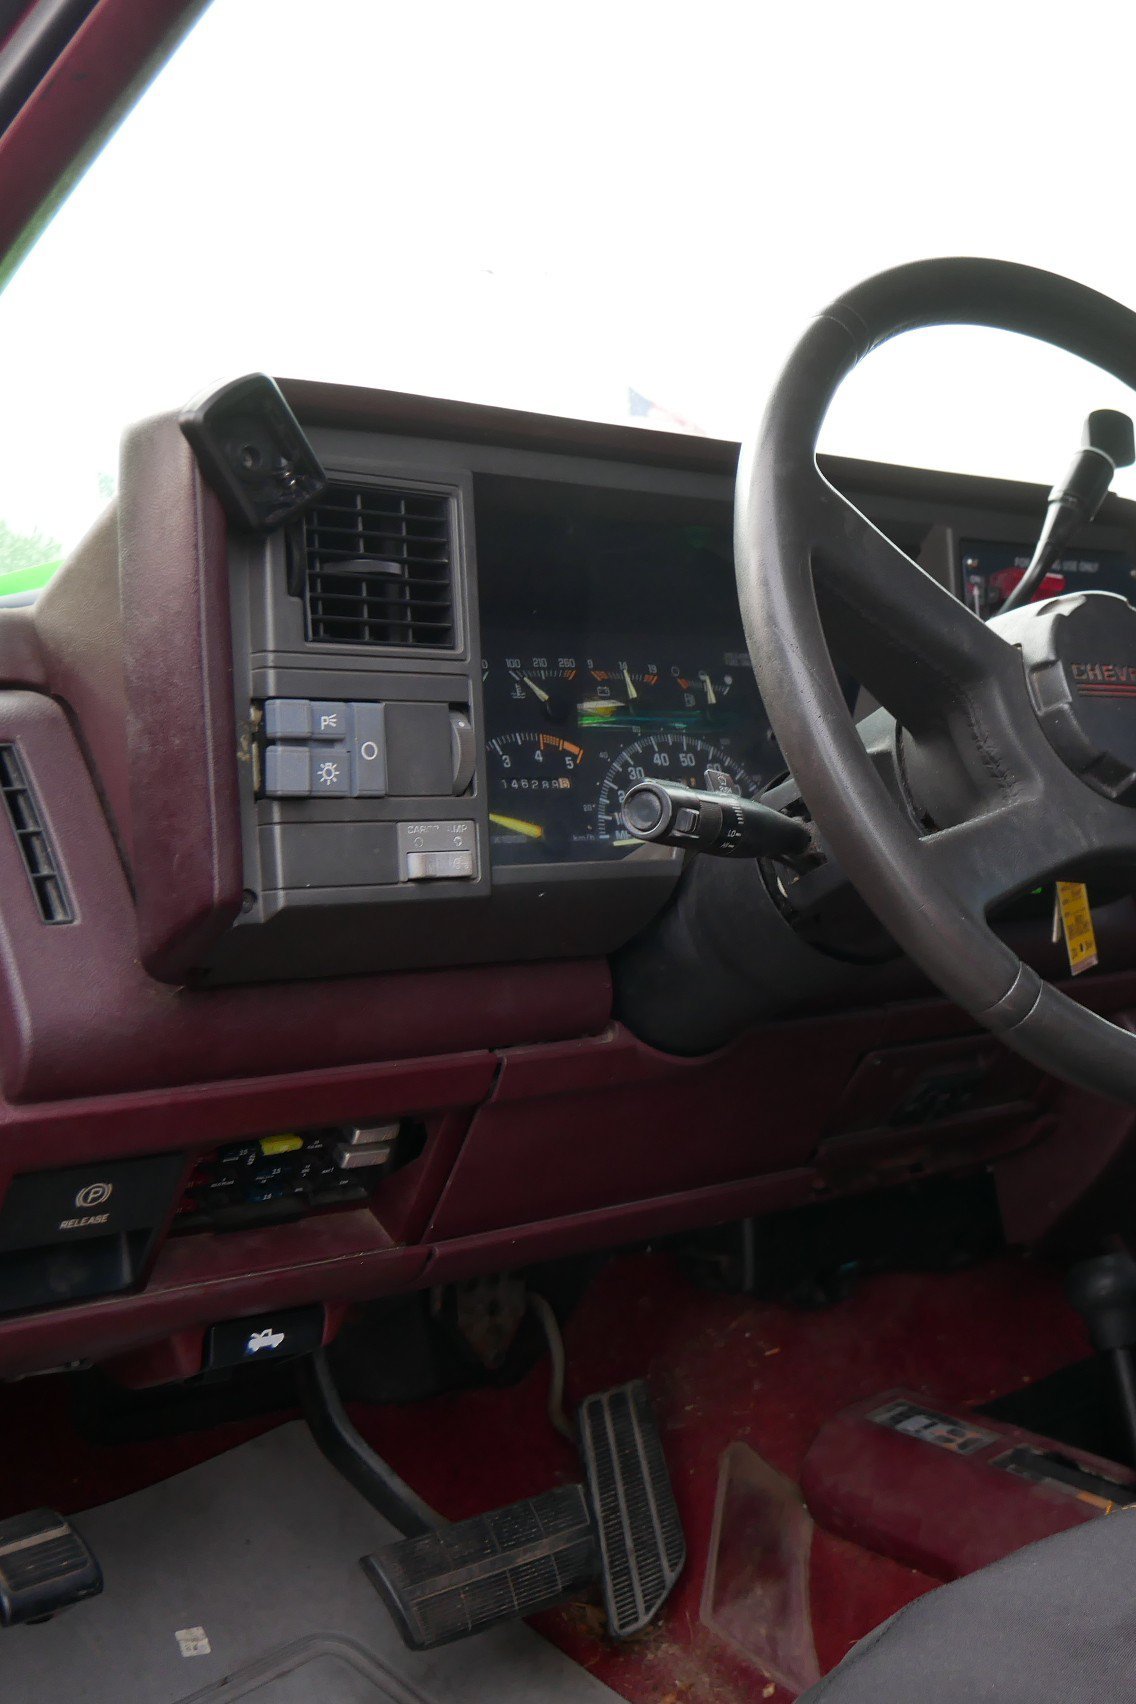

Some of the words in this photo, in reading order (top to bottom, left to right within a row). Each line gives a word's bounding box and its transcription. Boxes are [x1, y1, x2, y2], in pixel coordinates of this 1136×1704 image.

[505, 658, 521, 669] 100
[532, 658, 548, 668] 210
[502, 755, 512, 768] 3
[534, 750, 544, 763] 4
[565, 756, 575, 770] 5
[653, 753, 670, 767] 40
[679, 753, 696, 767] 50
[628, 767, 645, 780] 30
[60, 1213, 110, 1230] RELEASE
